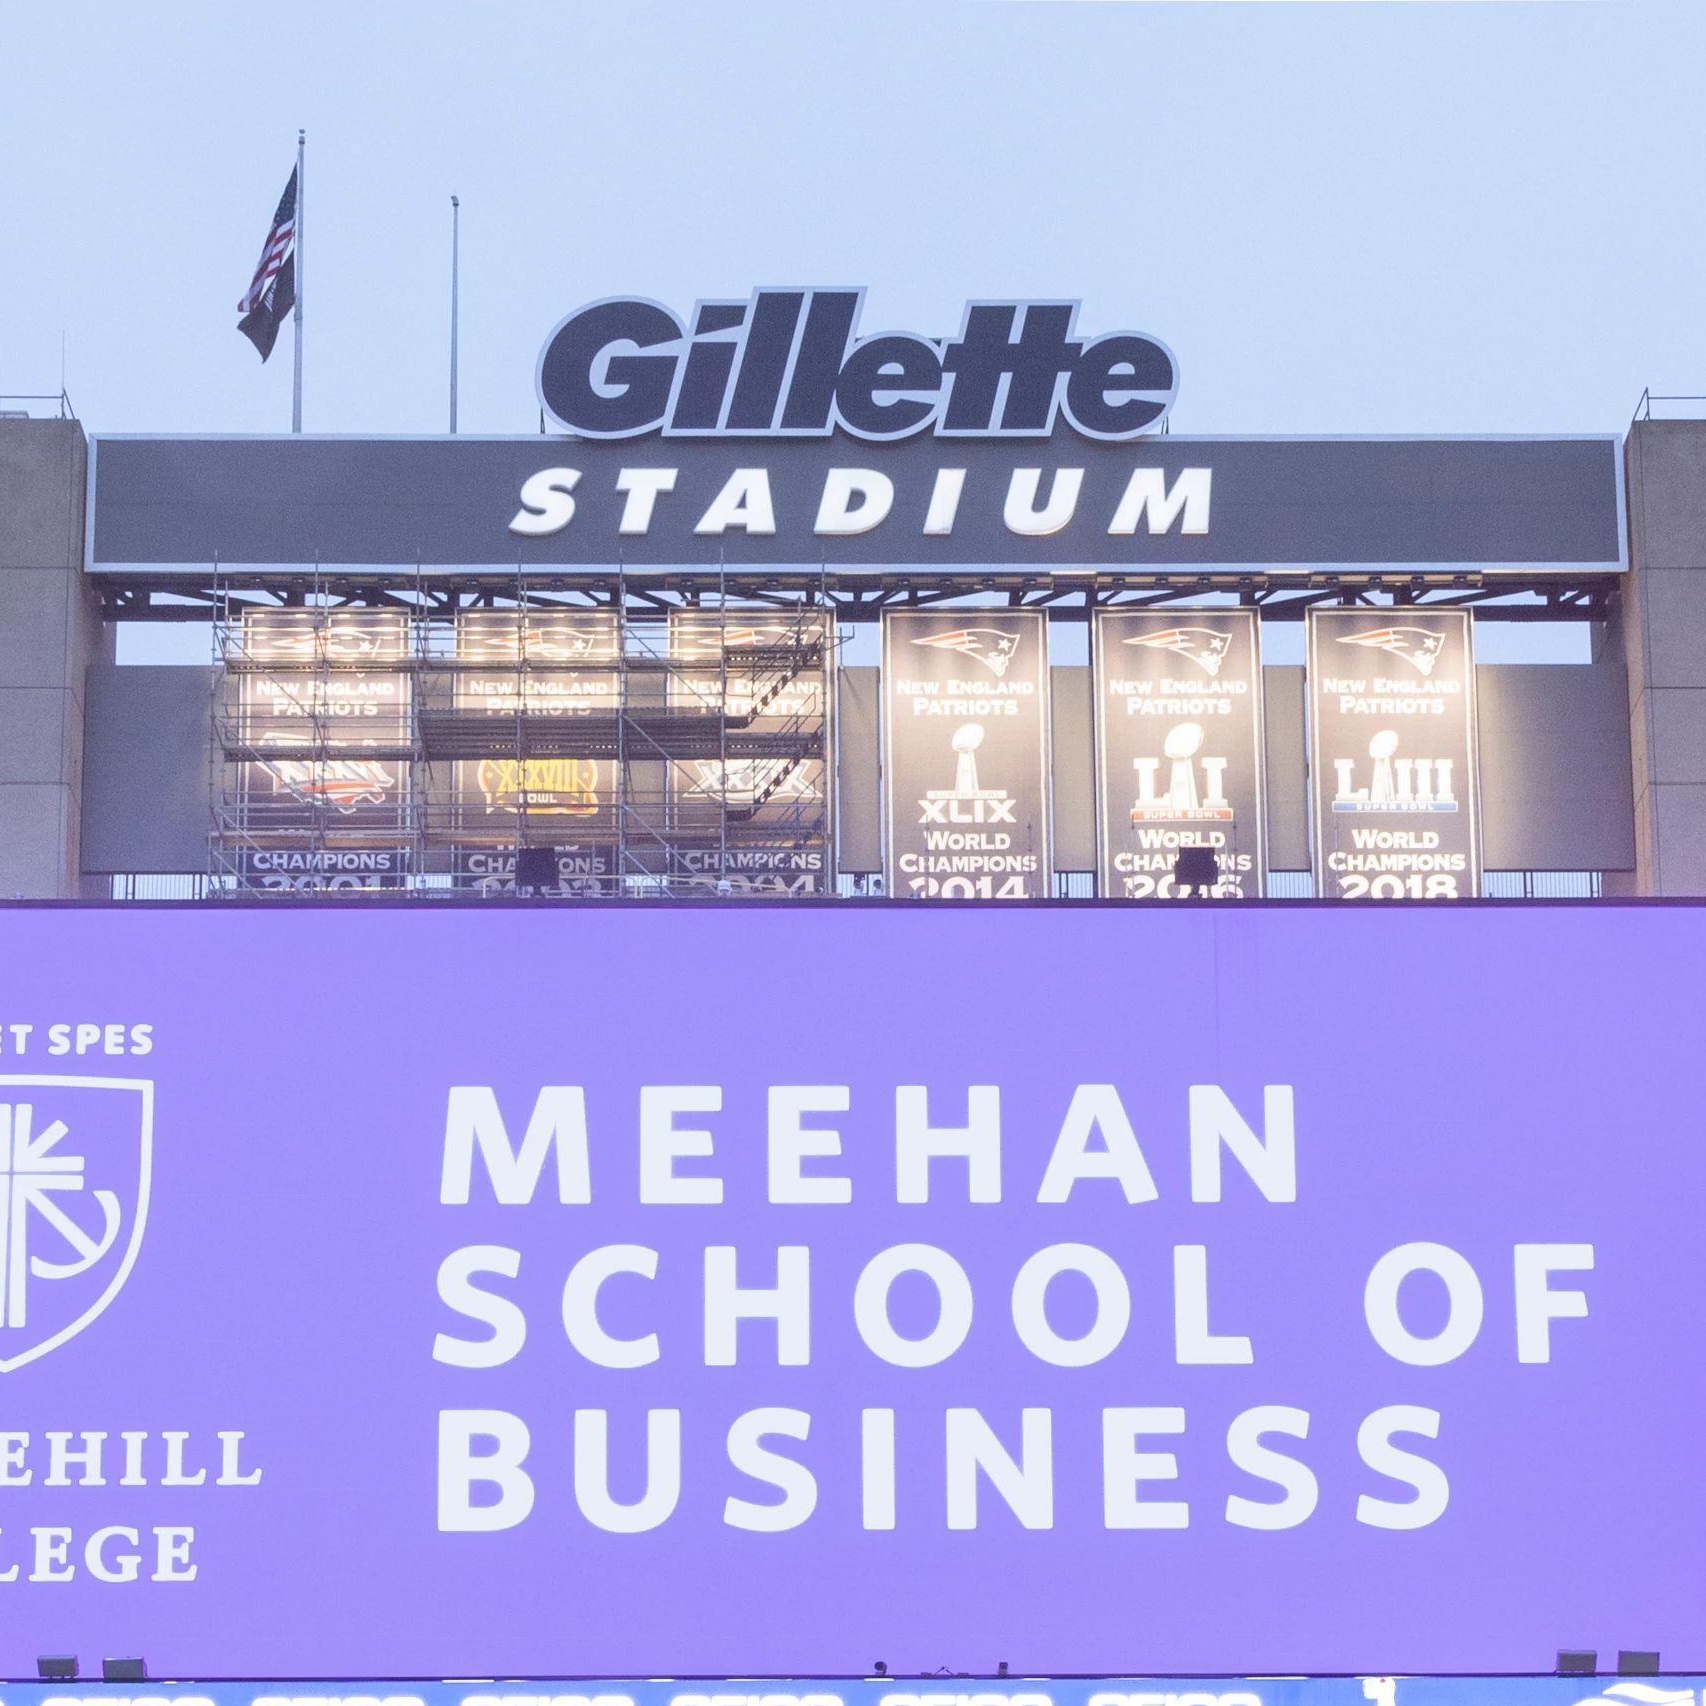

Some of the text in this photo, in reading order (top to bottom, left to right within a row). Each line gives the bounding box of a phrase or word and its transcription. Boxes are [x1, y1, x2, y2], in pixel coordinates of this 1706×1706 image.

[534, 286, 1181, 441] Gillette
[508, 466, 1213, 535] STADIUM
[469, 680, 514, 695] NEW
[896, 679, 1034, 695] NEW ENGLAND
[1109, 679, 1248, 695] NEW ENGLAND
[1323, 678, 1461, 694] NEW ENGLAND
[913, 698, 1019, 716] PATRIOTS
[1126, 697, 1232, 715] PATRIOTS
[1340, 696, 1446, 714] PATRIOTS
[917, 799, 1017, 824] XLIX
[923, 830, 1011, 850] WORLD
[1137, 829, 1226, 849] WORLD
[1351, 828, 1440, 849] WORLD
[253, 852, 391, 870] CHAMPIONS
[899, 853, 1038, 873] CHAMPIONS
[1327, 852, 1466, 872] CHAMPIONS
[47, 1023, 154, 1056] SPES
[439, 1083, 1297, 1206] MEEHAN
[431, 1241, 1596, 1370] SCHOOL OF
[436, 1403, 1451, 1535] BUSINESS
